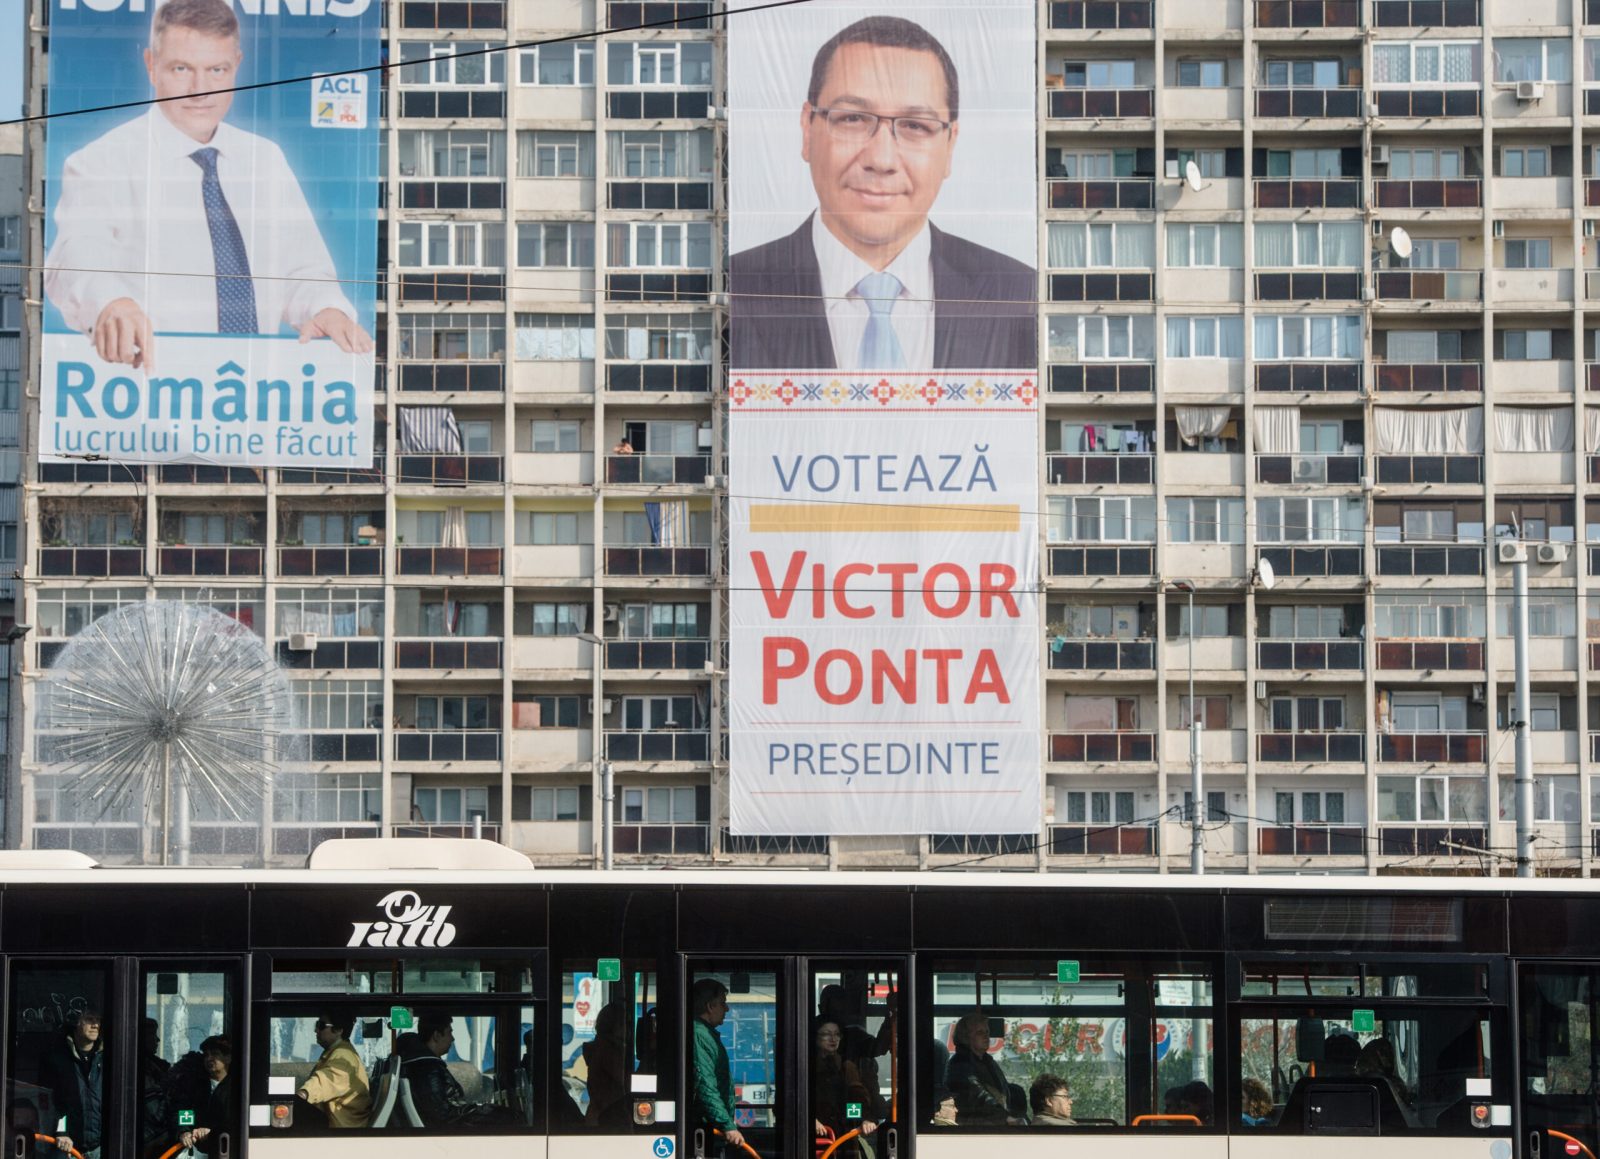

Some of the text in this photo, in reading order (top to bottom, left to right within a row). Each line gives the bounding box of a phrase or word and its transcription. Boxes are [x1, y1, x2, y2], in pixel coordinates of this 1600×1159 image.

[319, 78, 361, 94] ACL
[56, 360, 358, 424] România
[54, 422, 358, 457] lucrului bine făcut
[772, 444, 997, 492] VOTEAZĂ
[750, 551, 1021, 619] VICTOR
[763, 636, 1011, 705] PONTA
[769, 742, 1000, 785] PREȘEDINTE
